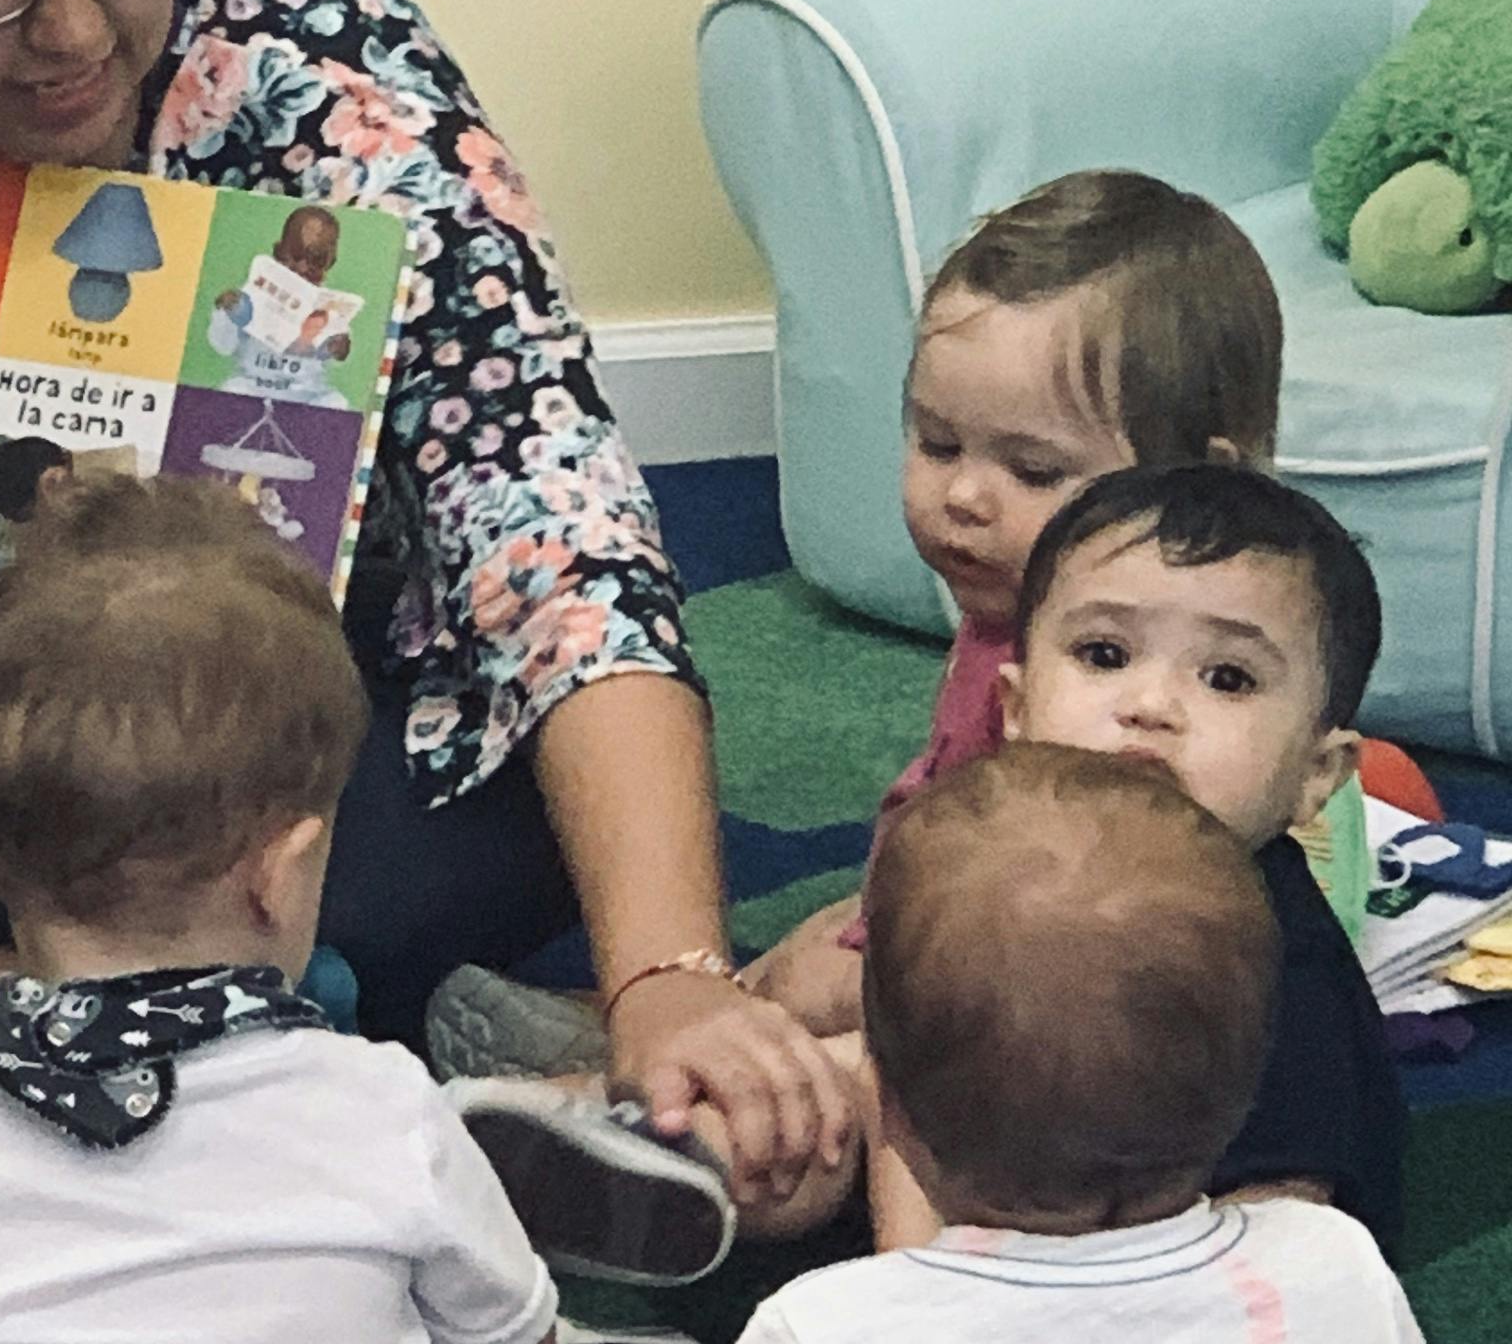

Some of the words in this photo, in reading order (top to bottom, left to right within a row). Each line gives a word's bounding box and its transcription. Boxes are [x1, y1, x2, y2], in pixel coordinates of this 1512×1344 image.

[47, 319, 130, 349] lámpara
[254, 352, 302, 374] libro
[70, 376, 103, 405] de
[111, 380, 134, 409] ir
[140, 392, 157, 413] a
[17, 398, 42, 426] la
[51, 411, 124, 439] cama
